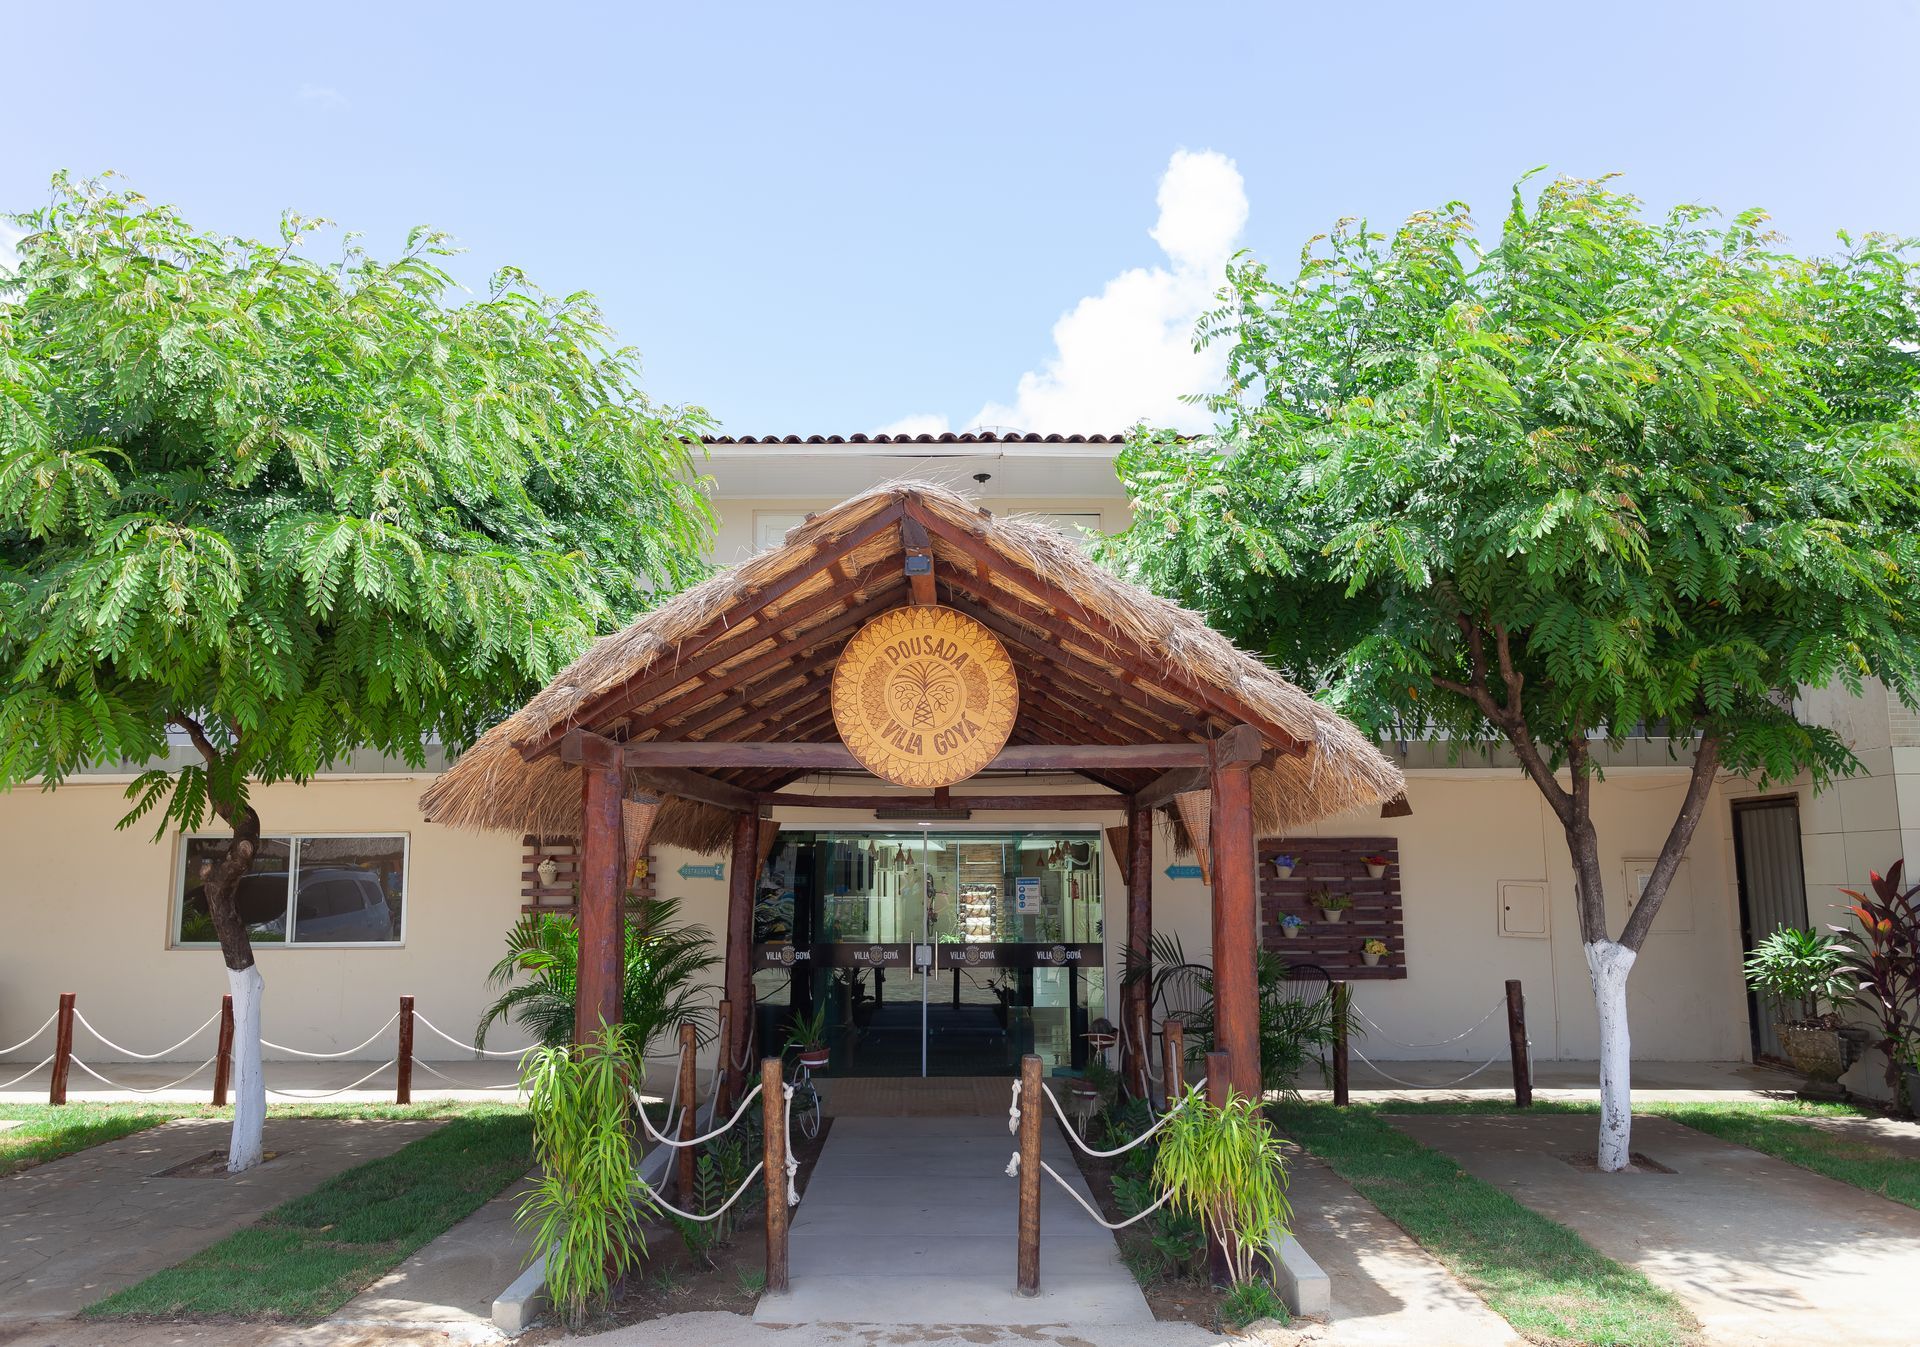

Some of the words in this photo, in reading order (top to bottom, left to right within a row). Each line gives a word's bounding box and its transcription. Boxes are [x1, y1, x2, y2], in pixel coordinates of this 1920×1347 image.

[884, 635, 970, 671] POUSADA
[933, 711, 983, 756] GOYÁ
[795, 949, 811, 960] GOYÁ
[883, 949, 899, 960] GOYÁ
[979, 949, 995, 960] GOYÁ
[1065, 949, 1082, 960] GOYÁ
